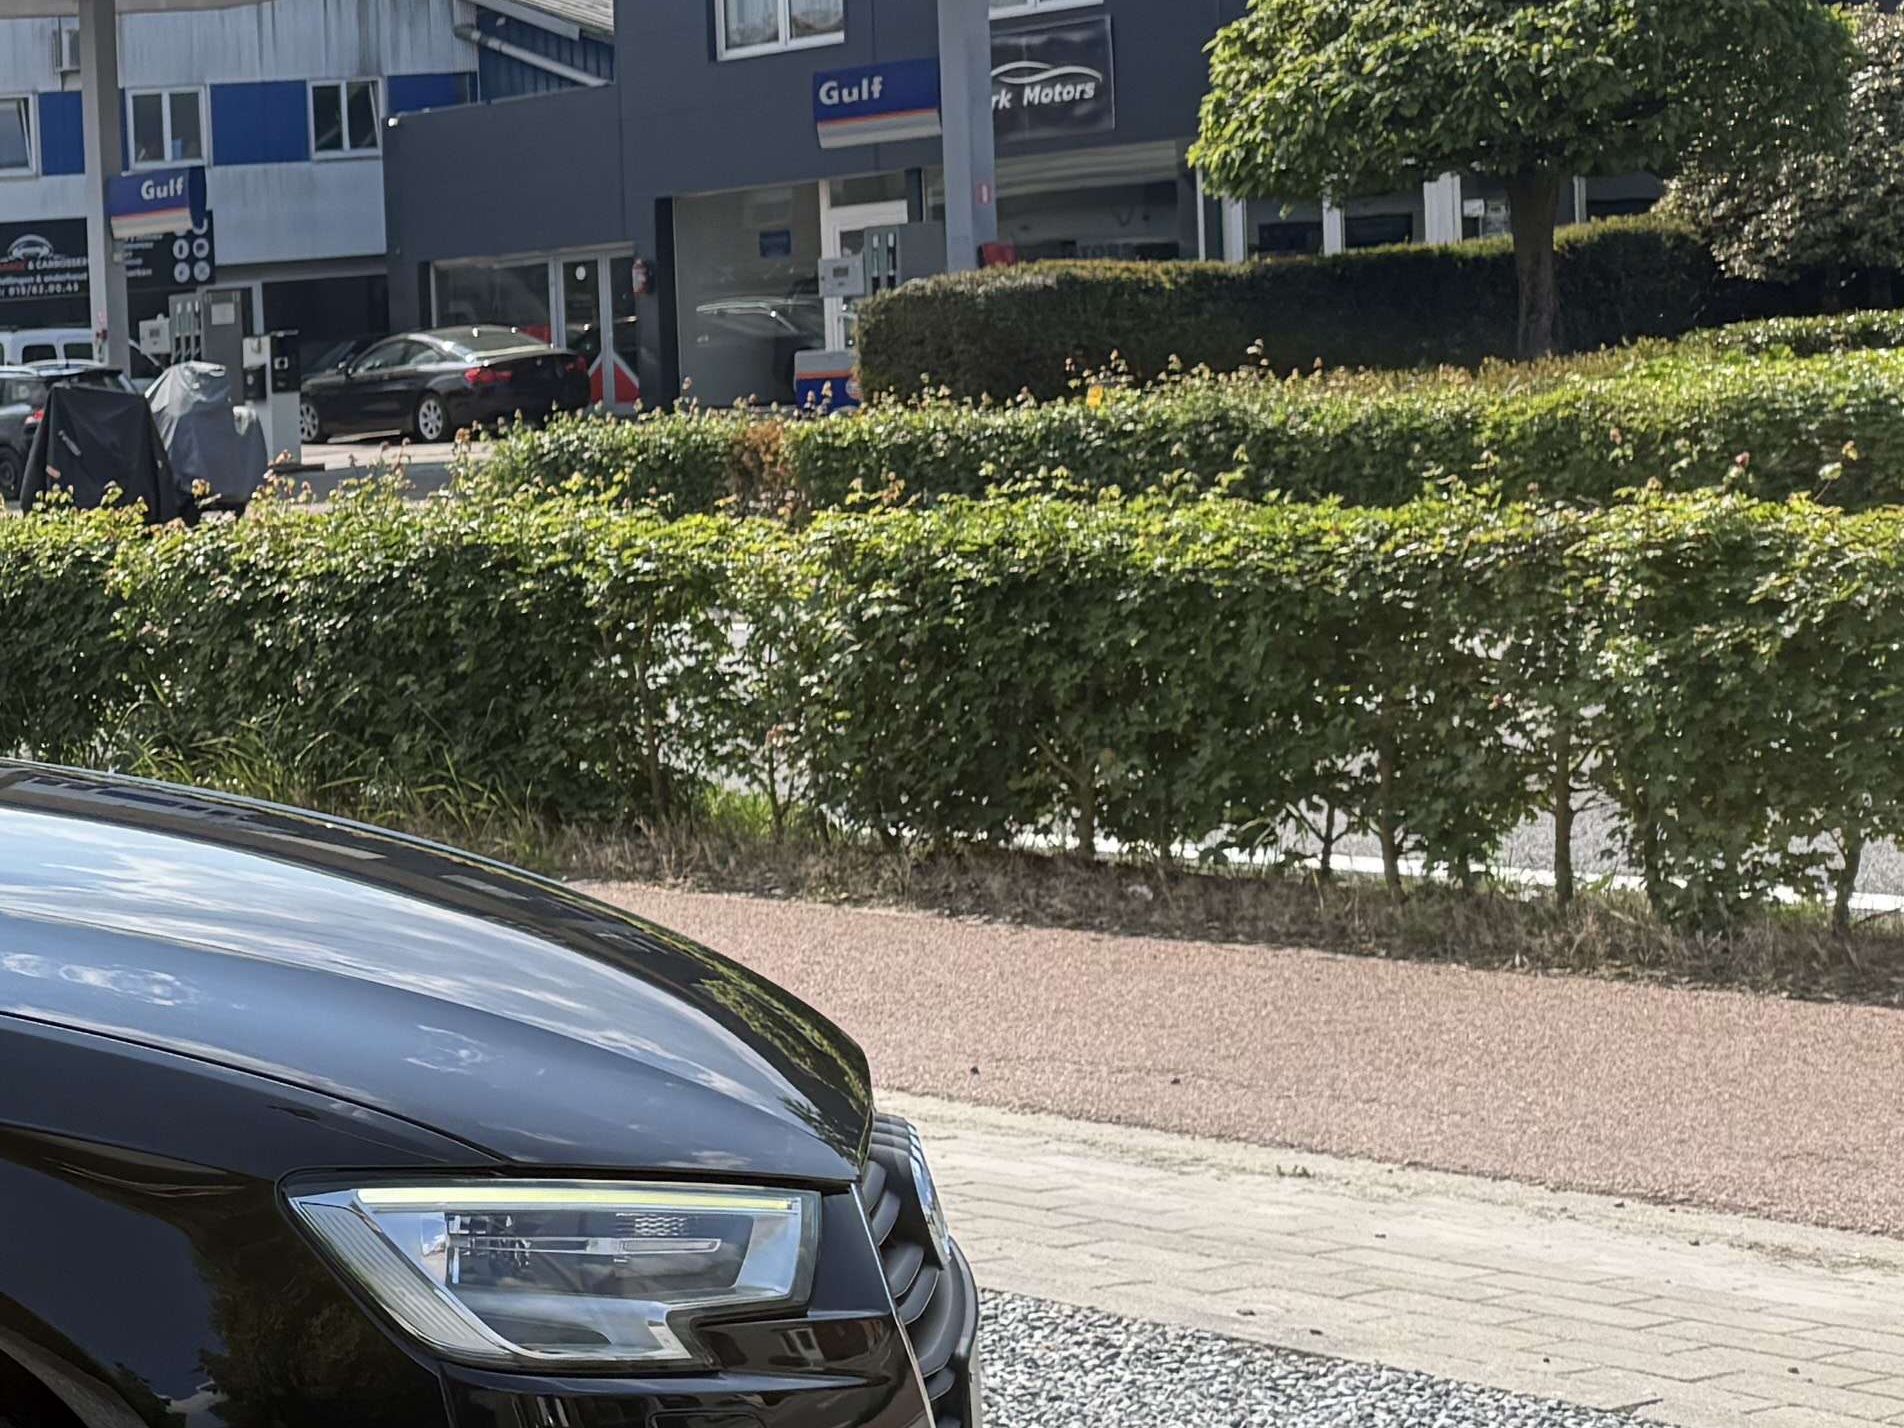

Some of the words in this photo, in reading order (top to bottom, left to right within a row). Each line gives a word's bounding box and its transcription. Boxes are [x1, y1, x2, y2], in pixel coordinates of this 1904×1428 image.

[819, 75, 883, 105] Gulf
[1023, 82, 1096, 107] Motors
[141, 176, 183, 200] Gulf
